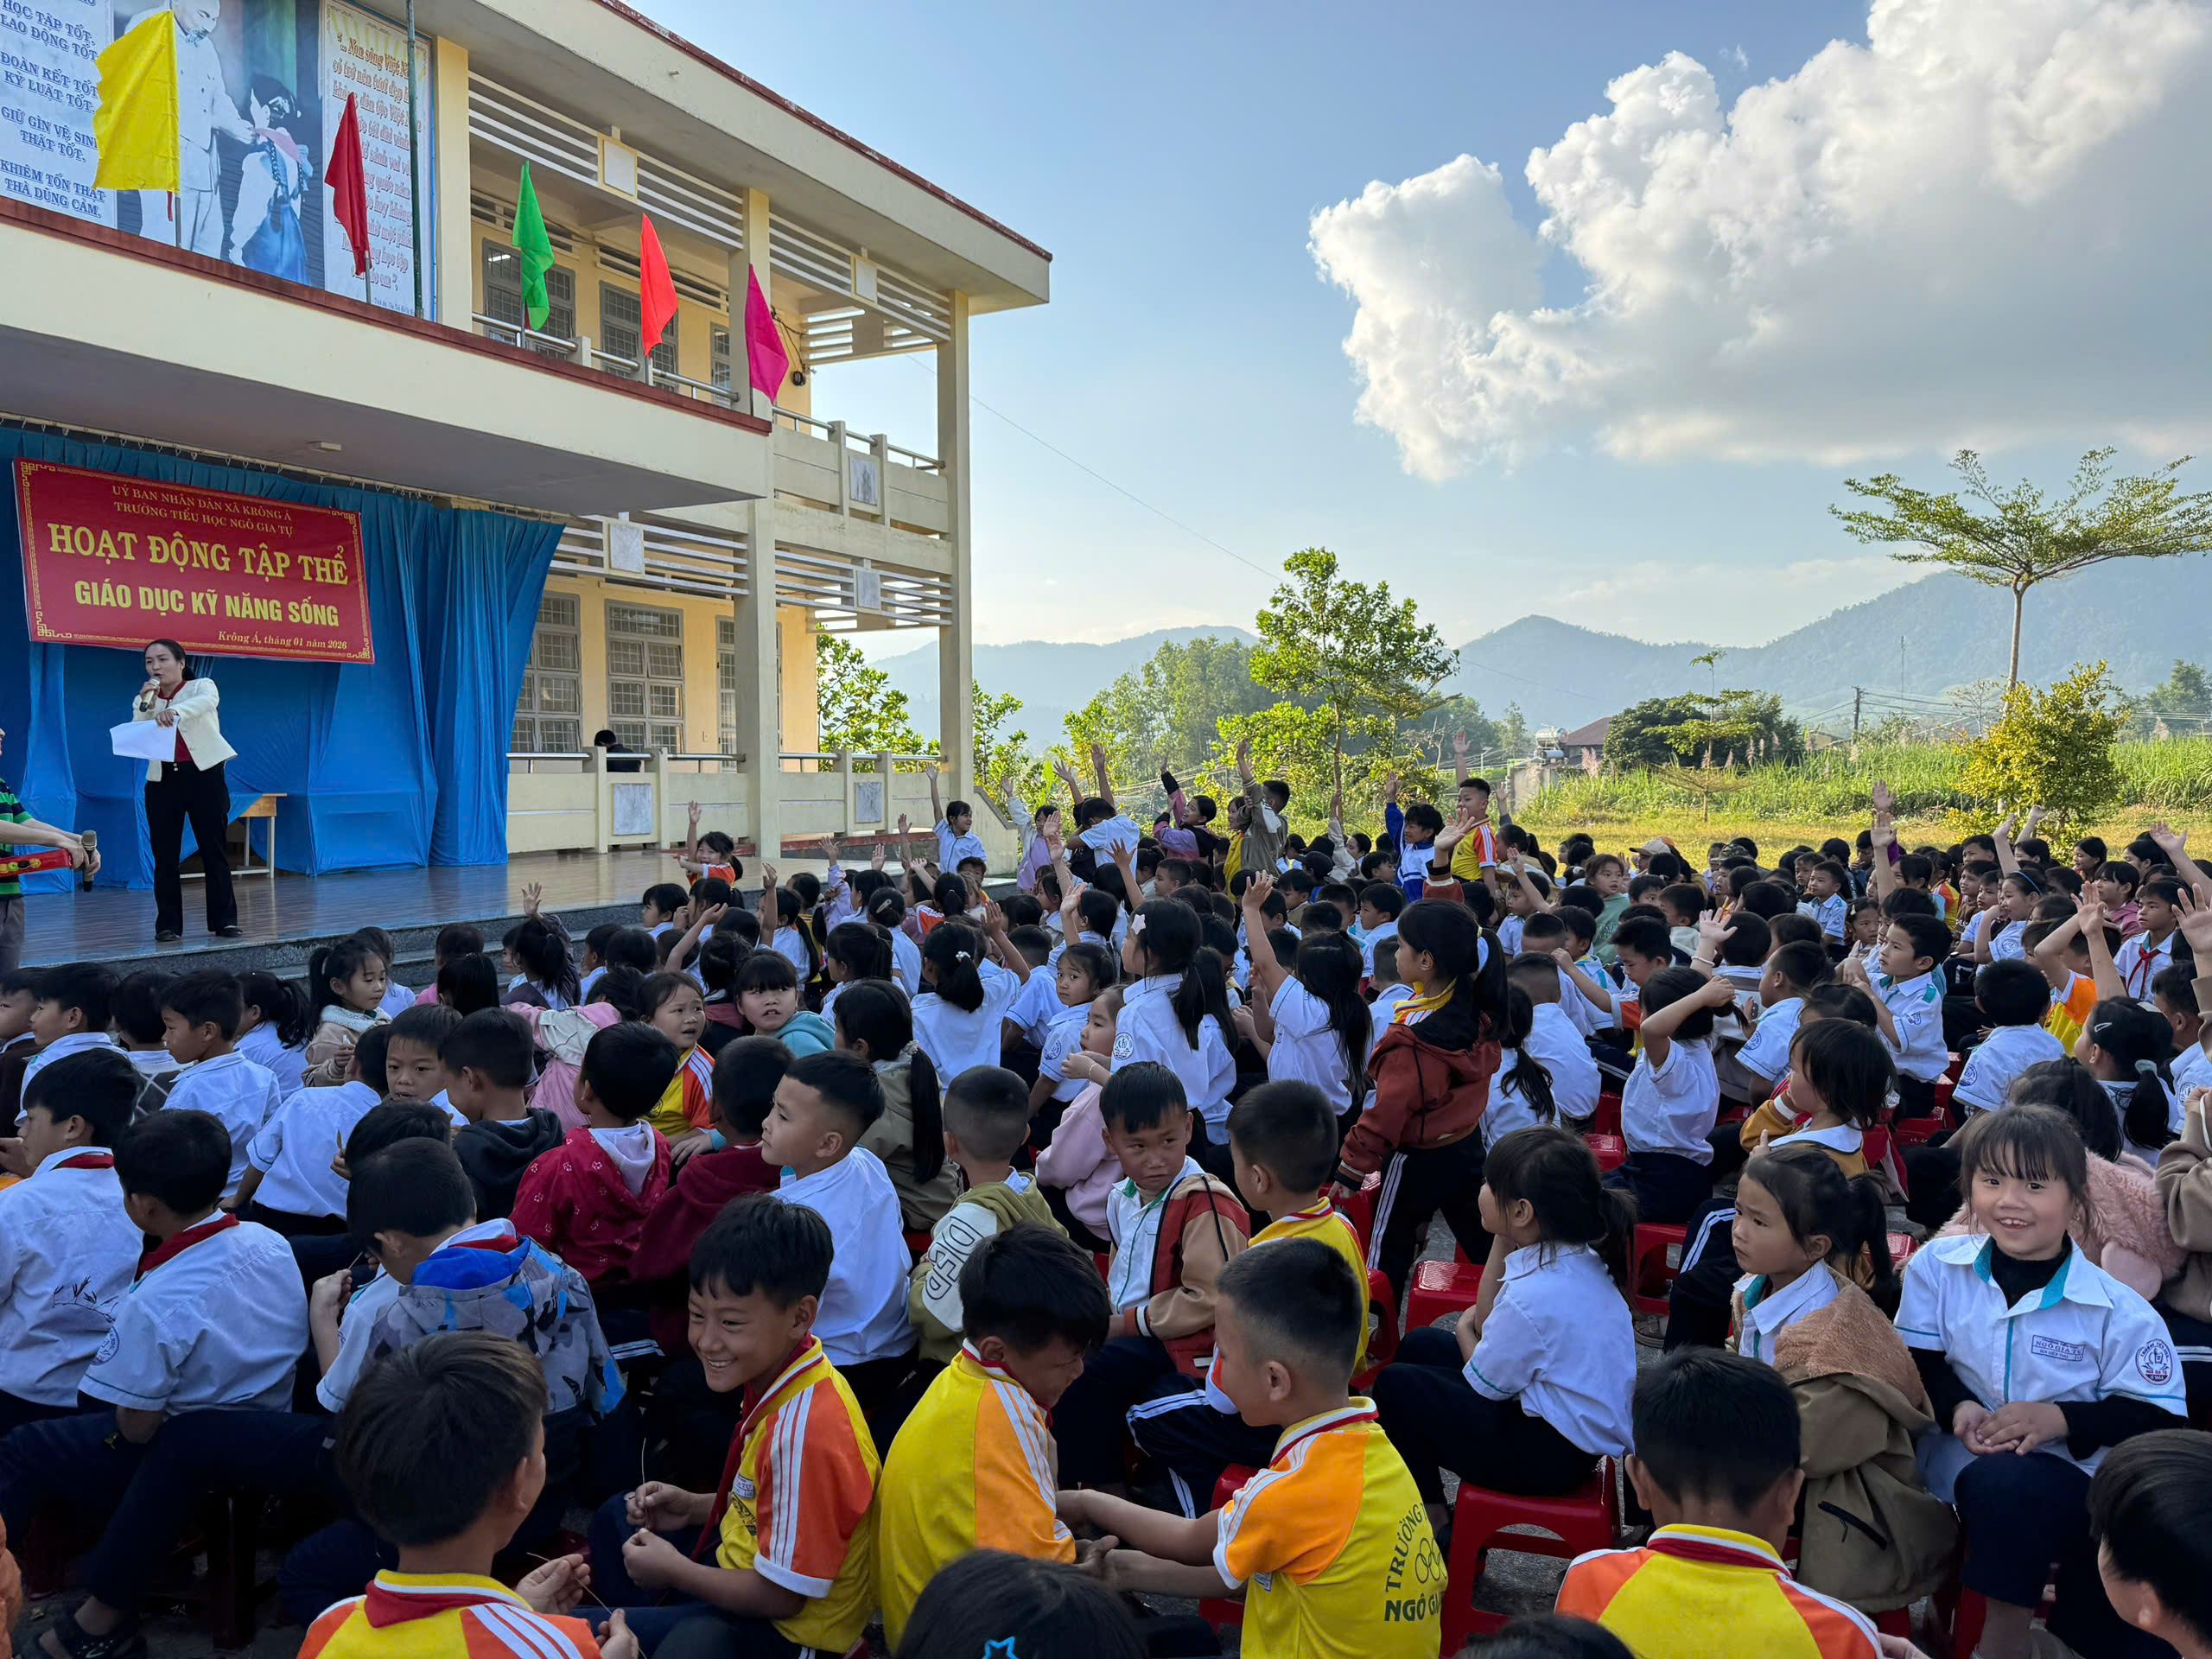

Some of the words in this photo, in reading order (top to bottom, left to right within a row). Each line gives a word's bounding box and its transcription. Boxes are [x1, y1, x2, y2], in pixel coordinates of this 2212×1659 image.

[0, 13, 28, 35] LAO
[31, 25, 70, 52] ĐỘNG
[3, 0, 33, 19] HỌC
[35, 11, 63, 31] TẬP
[0, 51, 39, 77] ĐOÀN
[41, 67, 71, 88] KẾT
[28, 79, 63, 102] LUẬT
[20, 130, 55, 151] THẬT
[0, 159, 44, 184] KHIÊM
[45, 173, 71, 193] TỐN
[114, 500, 168, 518] TRƯỜNG
[171, 506, 199, 523] TIỂU
[202, 514, 227, 528] HỌC
[230, 517, 254, 531] NGÔ
[257, 521, 276, 534] GIA
[277, 524, 294, 538] TỰ
[132, 488, 158, 501] BAN
[162, 492, 195, 507] NHÂN
[199, 497, 222, 512] DÂN
[226, 502, 240, 514] XÃ
[243, 505, 282, 520] KRÔNG
[48, 523, 138, 565] HOẠT
[147, 531, 231, 574] ĐỘNG
[238, 542, 290, 583] TẬP
[297, 544, 349, 586] THỂ
[75, 578, 132, 608] GIÁO
[138, 586, 185, 616] DỤC
[191, 588, 218, 616] KỸ
[225, 591, 283, 622] NĂNG
[288, 595, 340, 627] SỐNG
[218, 631, 250, 644] Krông
[264, 635, 292, 647] tháng
[293, 637, 303, 646] 01
[306, 639, 326, 648] năm
[327, 639, 347, 650] 2026
[1385, 1503, 1423, 1592] TRƯỜNG
[1384, 1593, 1426, 1622] NGÔ
